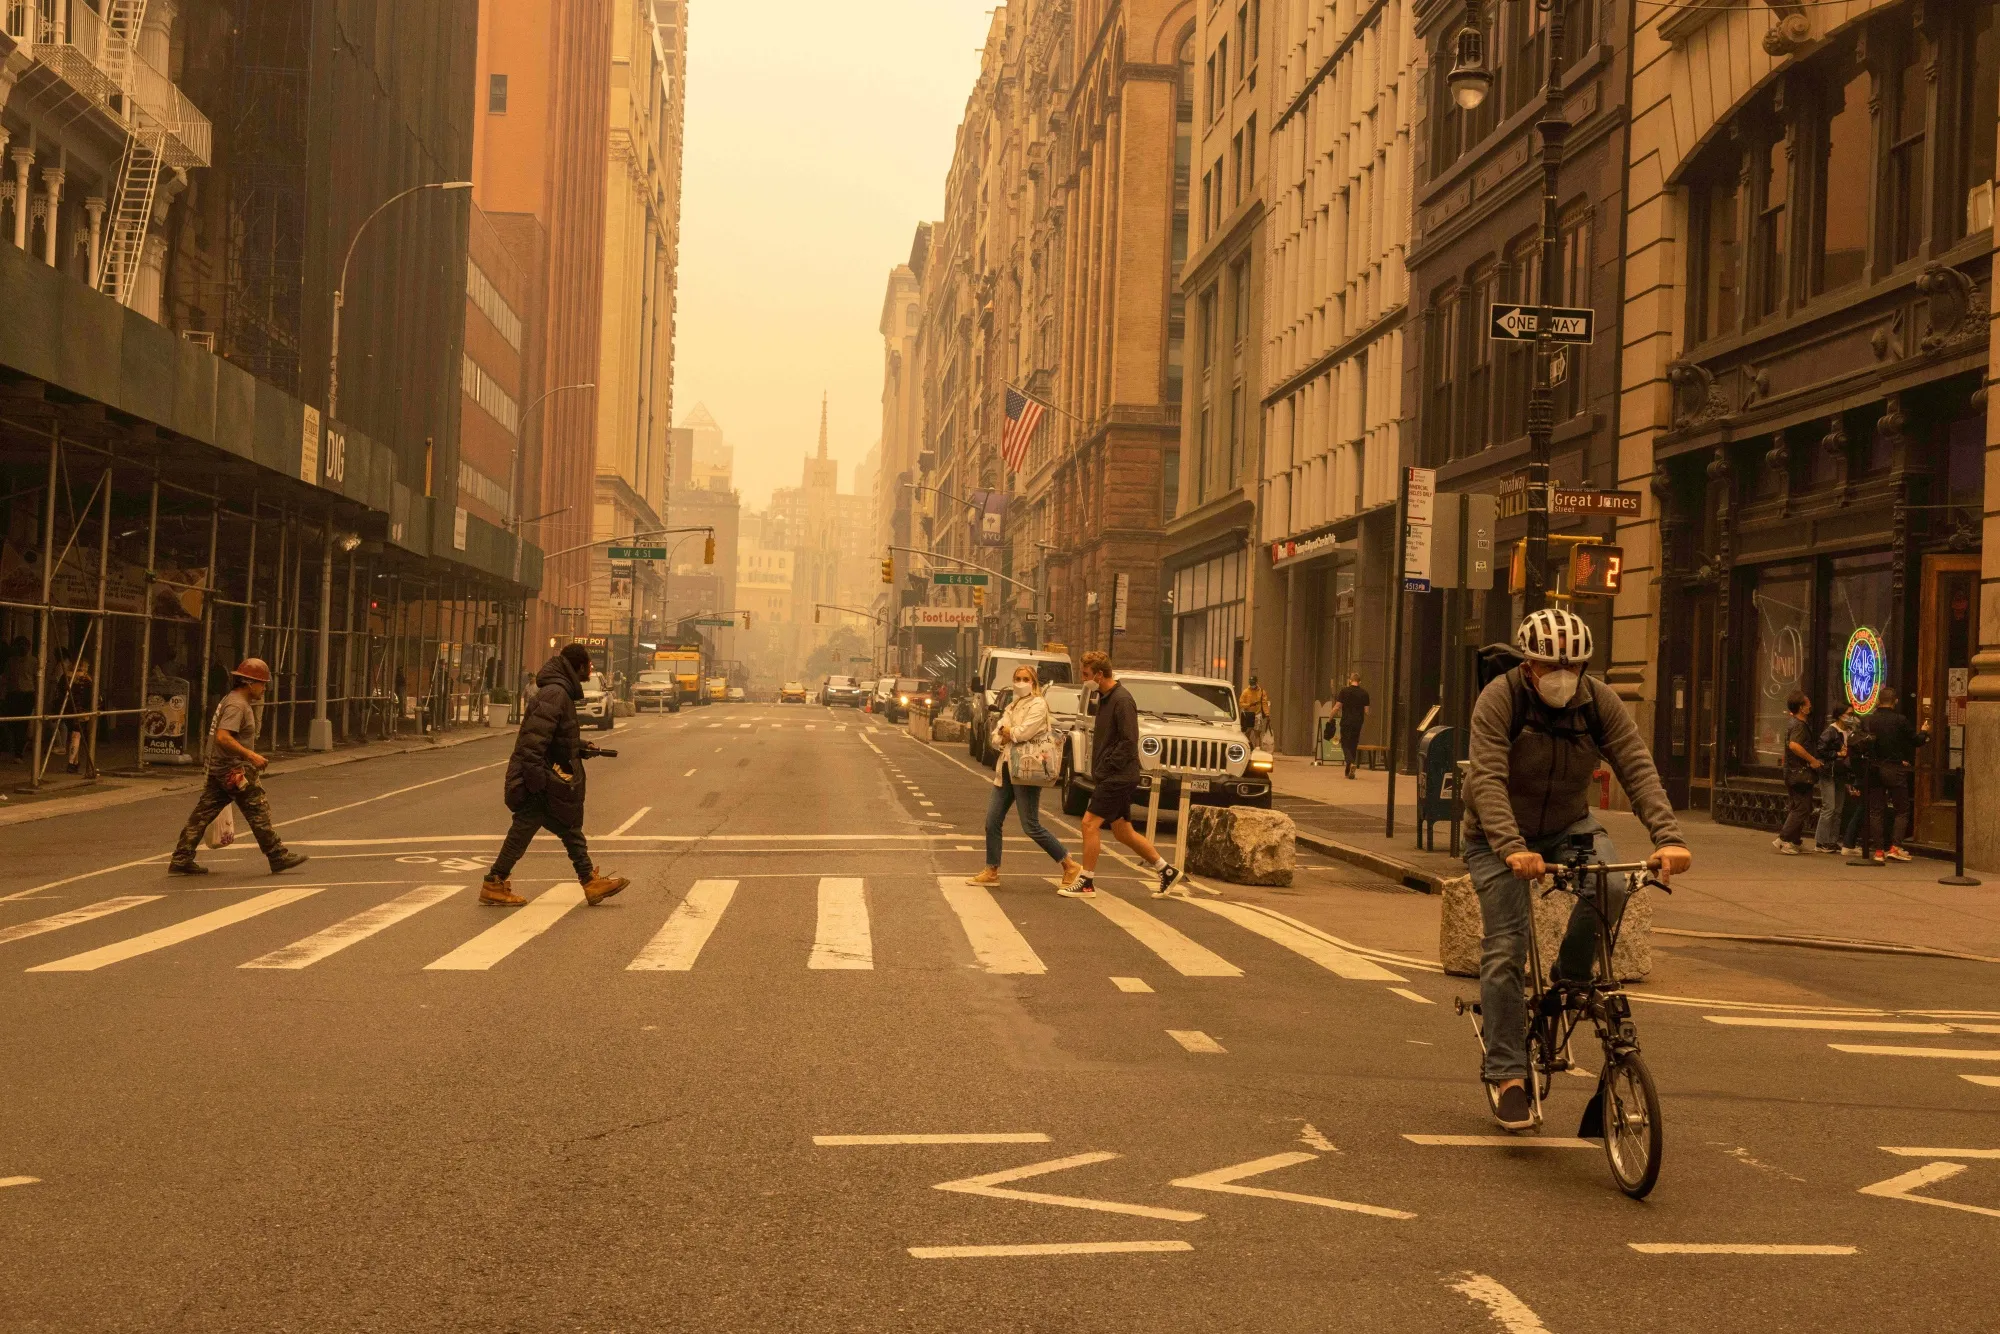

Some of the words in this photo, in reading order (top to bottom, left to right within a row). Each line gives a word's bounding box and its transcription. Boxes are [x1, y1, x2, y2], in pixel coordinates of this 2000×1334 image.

[1507, 316, 1535, 331] ONE
[1552, 318, 1579, 333] WAY
[326, 429, 345, 482] DIG
[1555, 493, 1592, 507] Great
[1598, 495, 1637, 509] Jnes
[623, 549, 631, 557] W
[643, 550, 651, 558] St
[1606, 557, 1620, 587] 2
[950, 575, 954, 583] E
[956, 575, 962, 583] 4
[964, 575, 972, 583] St
[922, 611, 943, 623] Foot
[944, 612, 975, 623] Locker
[590, 638, 605, 646] POT
[144, 746, 181, 755] Smoothie
